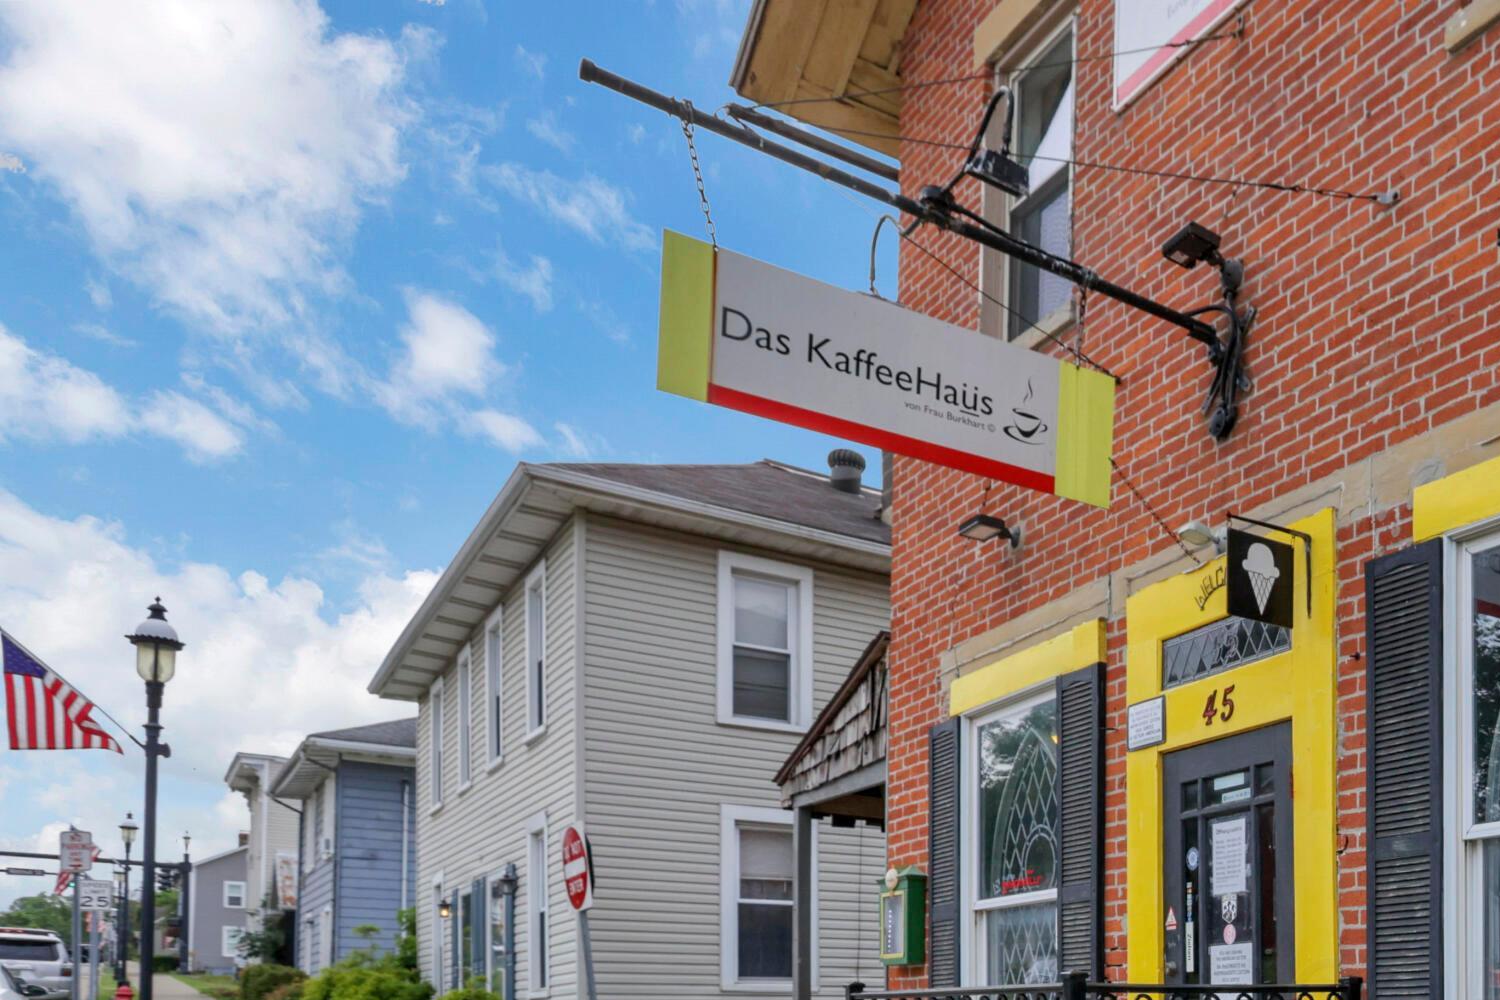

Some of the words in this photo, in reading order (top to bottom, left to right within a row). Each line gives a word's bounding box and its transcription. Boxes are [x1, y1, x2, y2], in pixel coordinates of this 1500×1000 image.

[722, 306, 791, 356] Das
[904, 401, 921, 413] von
[924, 405, 944, 419] Frau
[947, 412, 985, 431] Burkhart
[1193, 565, 1227, 611] WELC
[1202, 684, 1236, 726] 45
[80, 895, 110, 908] 25
